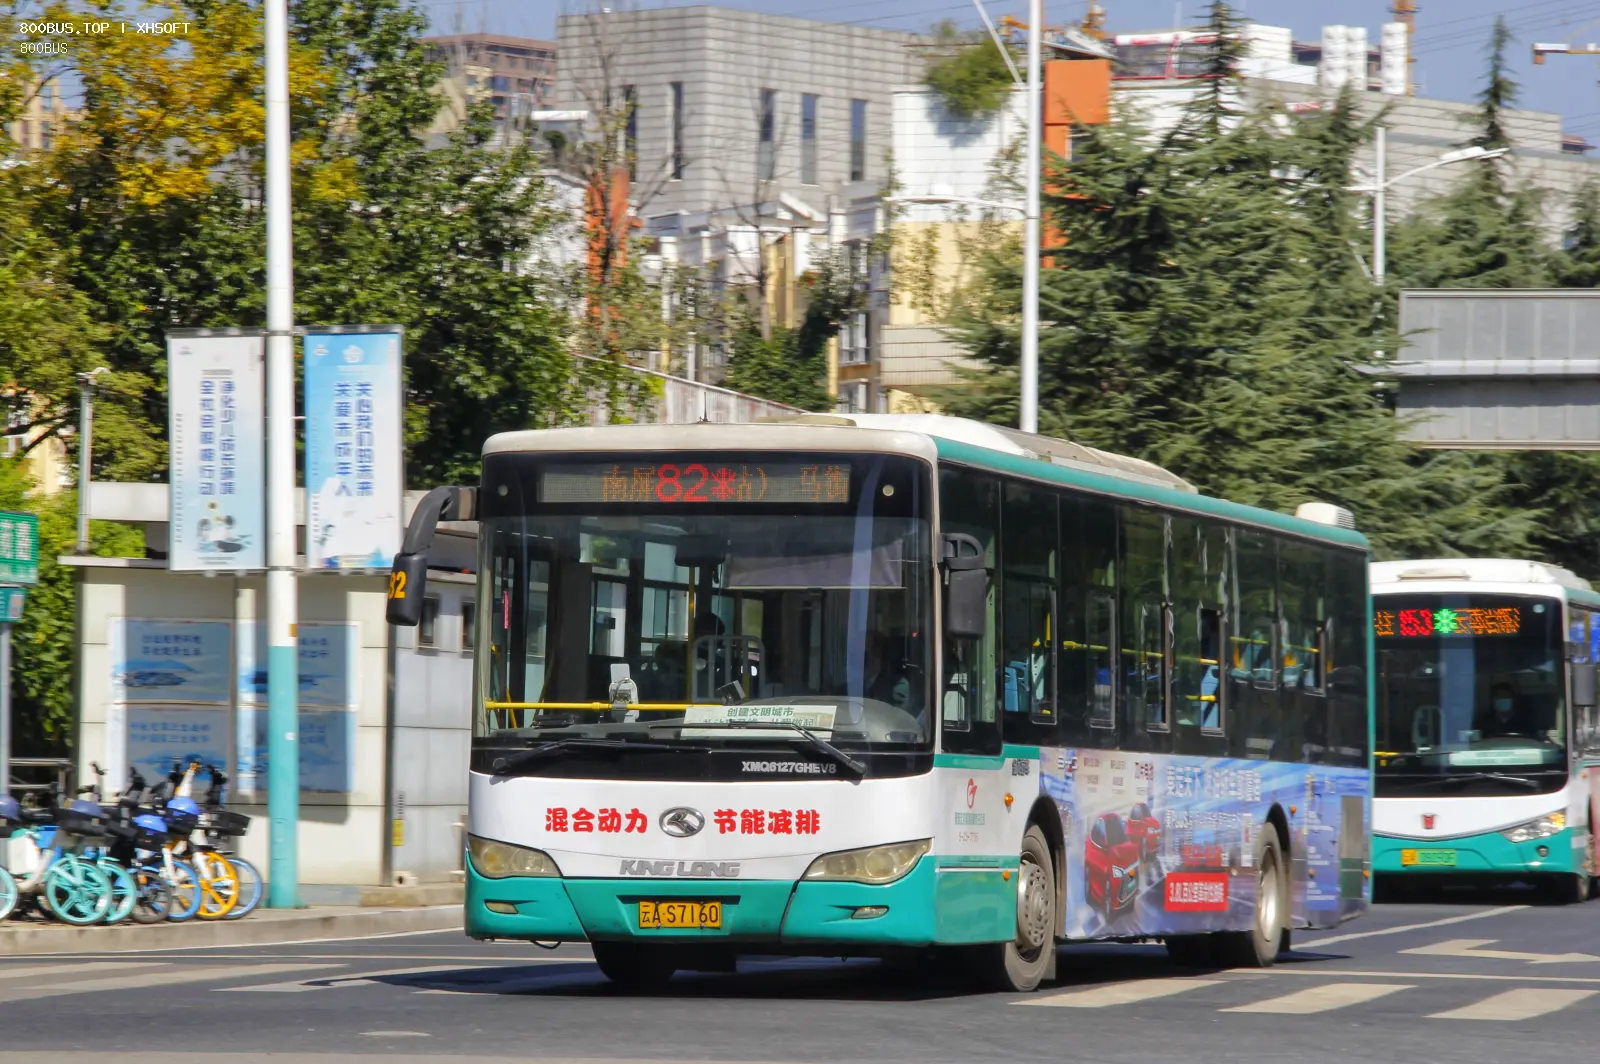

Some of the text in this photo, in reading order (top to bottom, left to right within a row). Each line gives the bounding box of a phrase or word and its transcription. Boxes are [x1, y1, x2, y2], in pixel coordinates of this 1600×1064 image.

[655, 463, 709, 503] 82
[727, 706, 795, 717] 创建文明城市
[741, 761, 837, 774] XMQ6127GHEV8
[545, 807, 821, 836] 混合动力 节能减排
[619, 860, 741, 878] KING LONG
